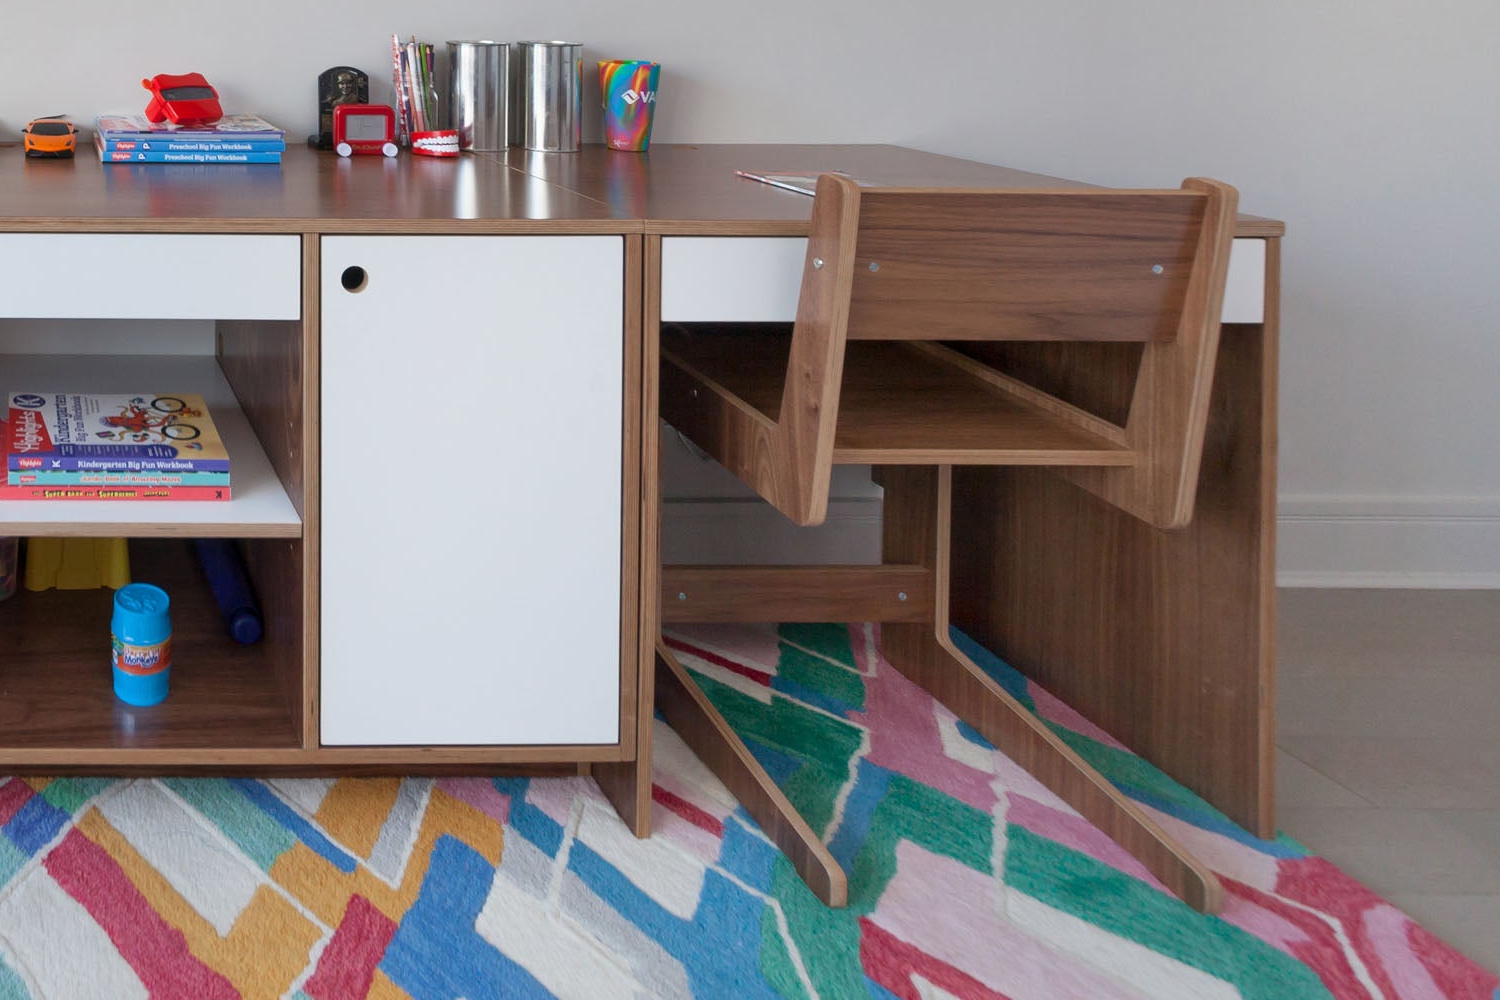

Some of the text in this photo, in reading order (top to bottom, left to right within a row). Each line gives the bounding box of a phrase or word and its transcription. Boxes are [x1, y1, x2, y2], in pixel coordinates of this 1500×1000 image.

[199, 143, 209, 151] Big
[194, 154, 204, 162] Big
[53, 394, 71, 443] Kindergarten
[13, 411, 43, 453] Highlights
[78, 461, 127, 469] Kindergarten
[128, 461, 140, 469] Big
[156, 461, 194, 469] Workbook
